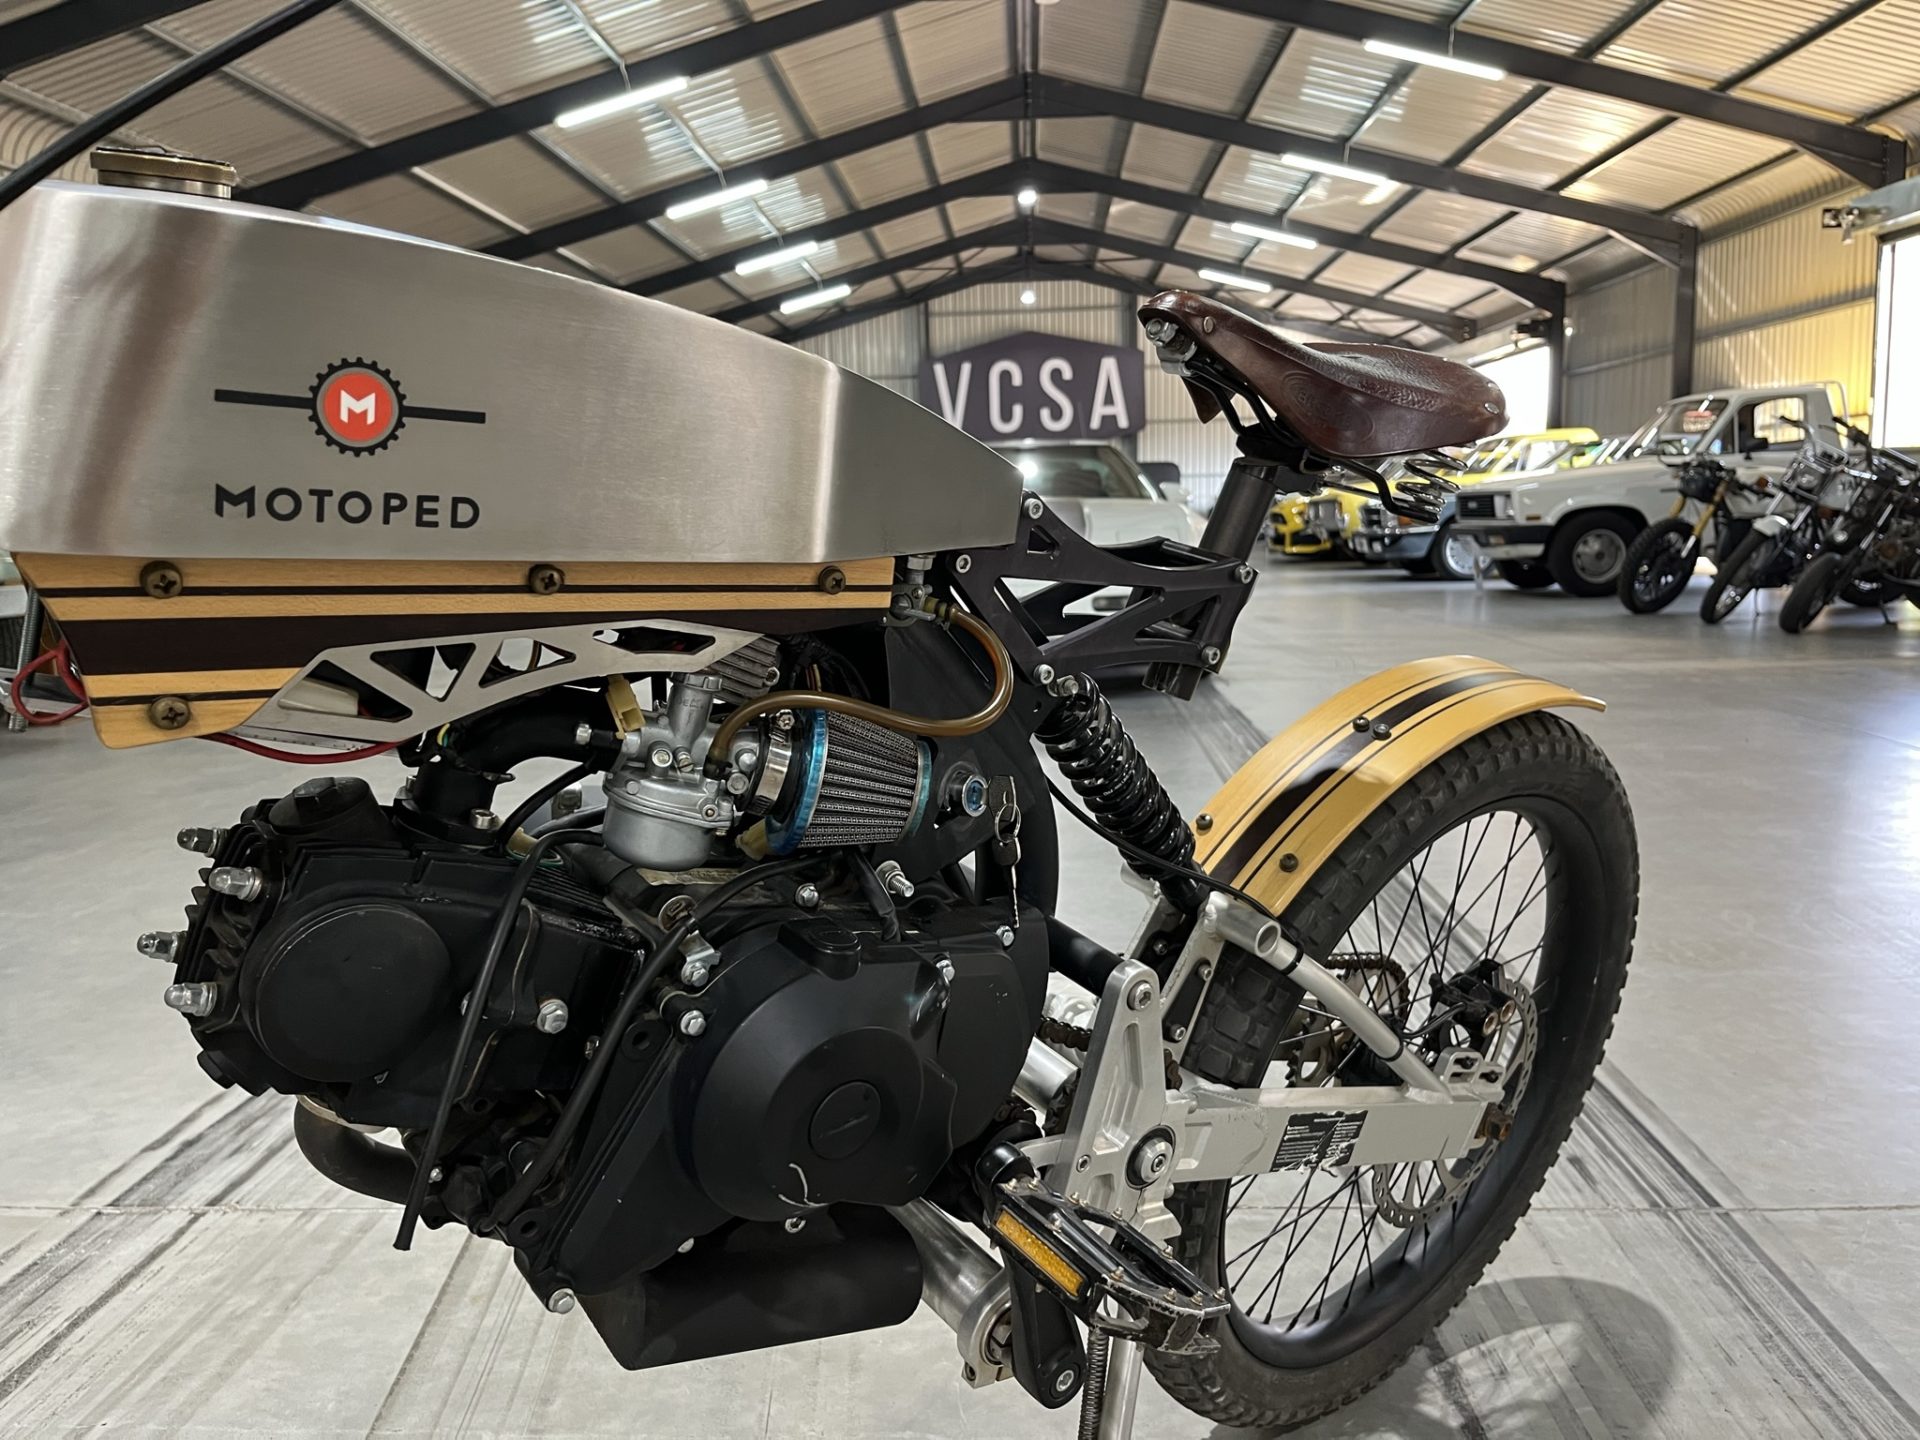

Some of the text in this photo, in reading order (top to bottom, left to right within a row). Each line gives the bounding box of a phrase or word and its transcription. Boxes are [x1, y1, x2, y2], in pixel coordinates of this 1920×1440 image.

[340, 389, 376, 425] M
[933, 356, 1129, 433] VCSA
[215, 483, 480, 529] MOTOPED
